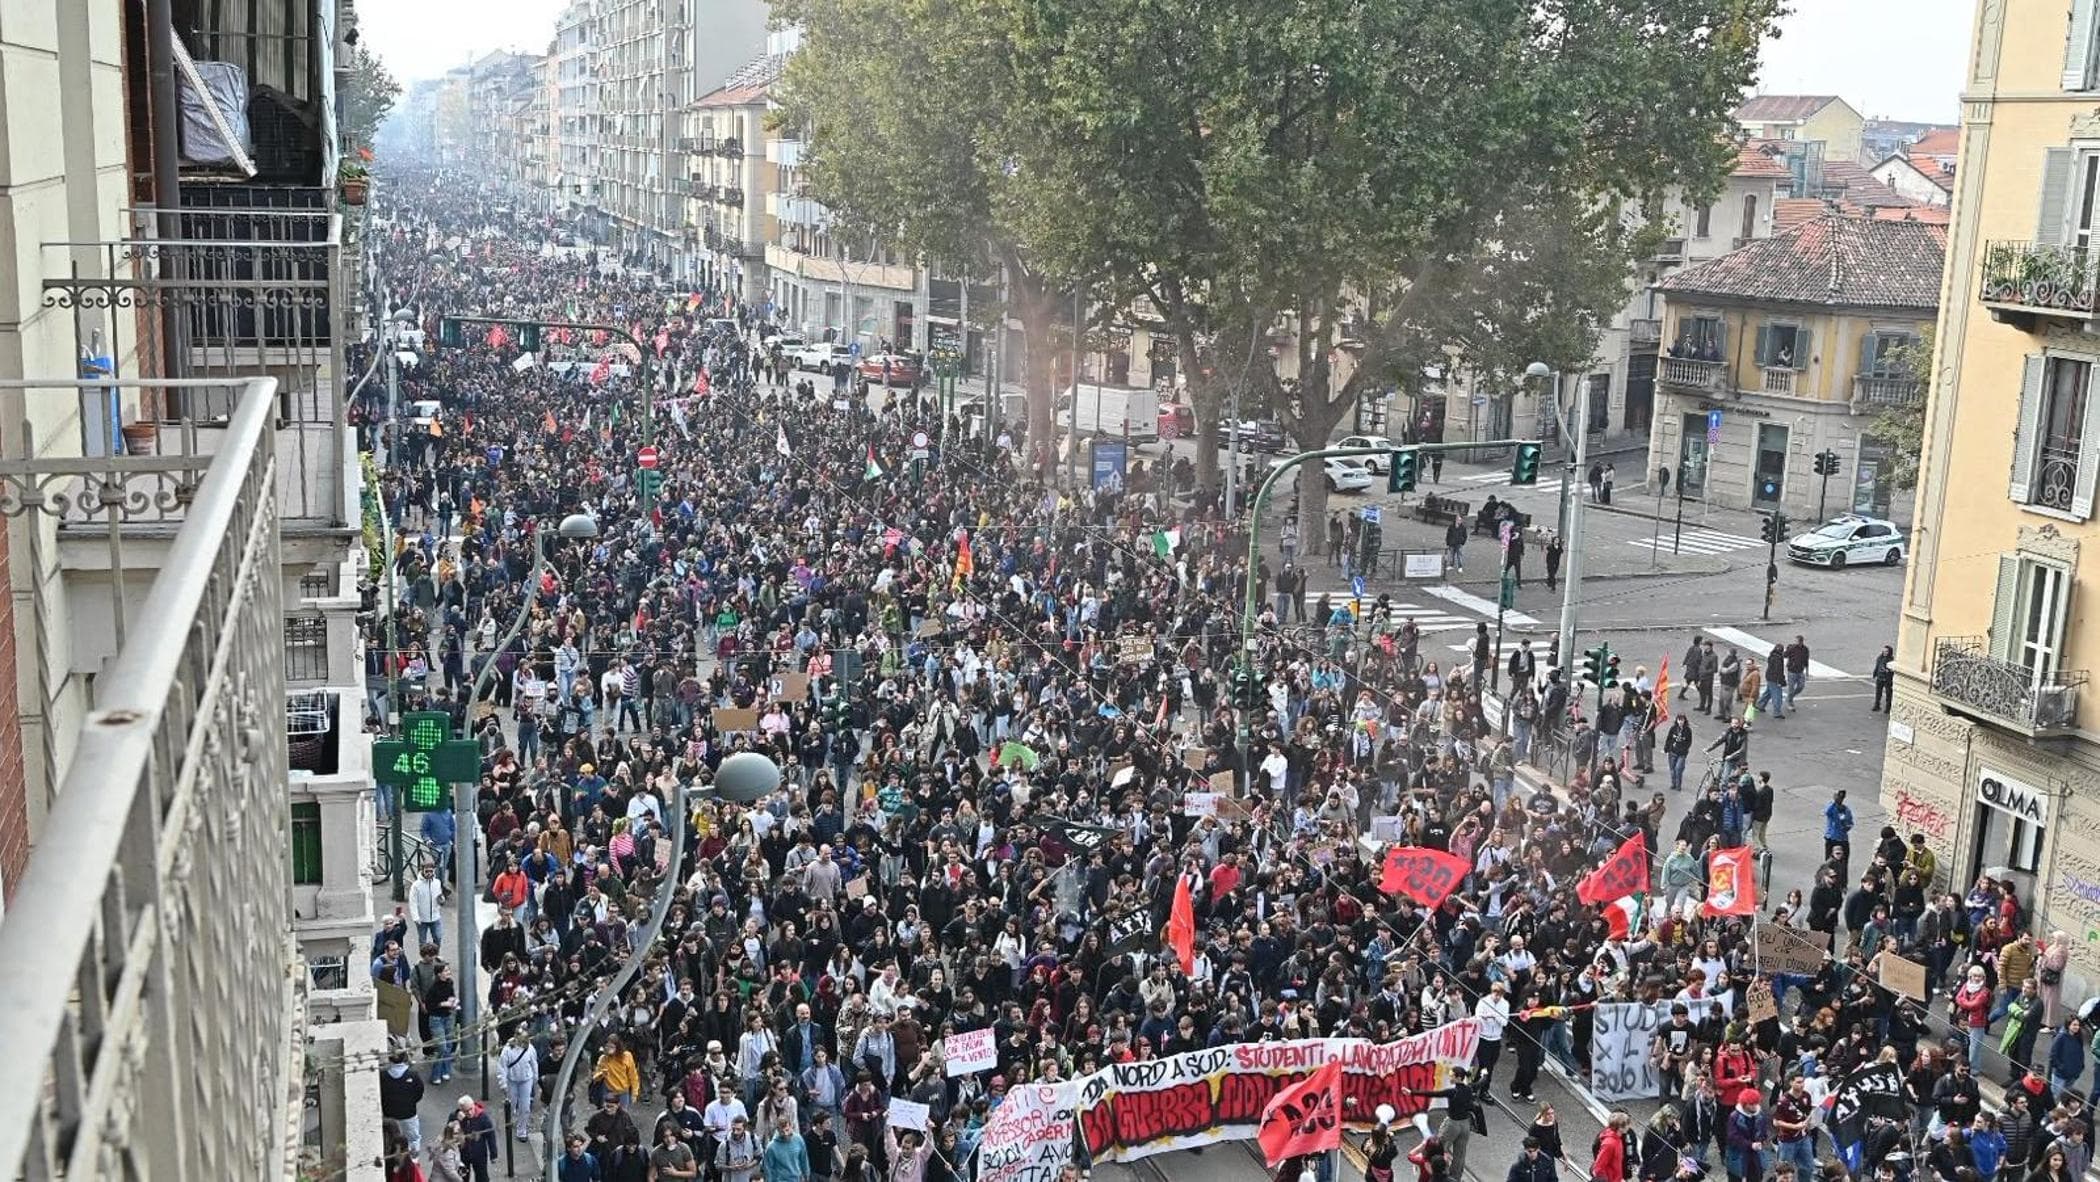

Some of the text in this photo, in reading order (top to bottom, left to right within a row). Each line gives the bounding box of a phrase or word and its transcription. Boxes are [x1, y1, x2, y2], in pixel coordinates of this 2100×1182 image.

[393, 752, 430, 775] 46
[1981, 777, 2040, 820] OLMA
[1082, 1076, 1109, 1104] DA
[1112, 1060, 1168, 1087] NORD
[1170, 1058, 1186, 1080] A
[1186, 1049, 1232, 1078] SUD:
[1234, 1043, 1324, 1070] STUDENTI
[1082, 1099, 1115, 1151] LA
[1112, 1080, 1214, 1142] GUERRA
